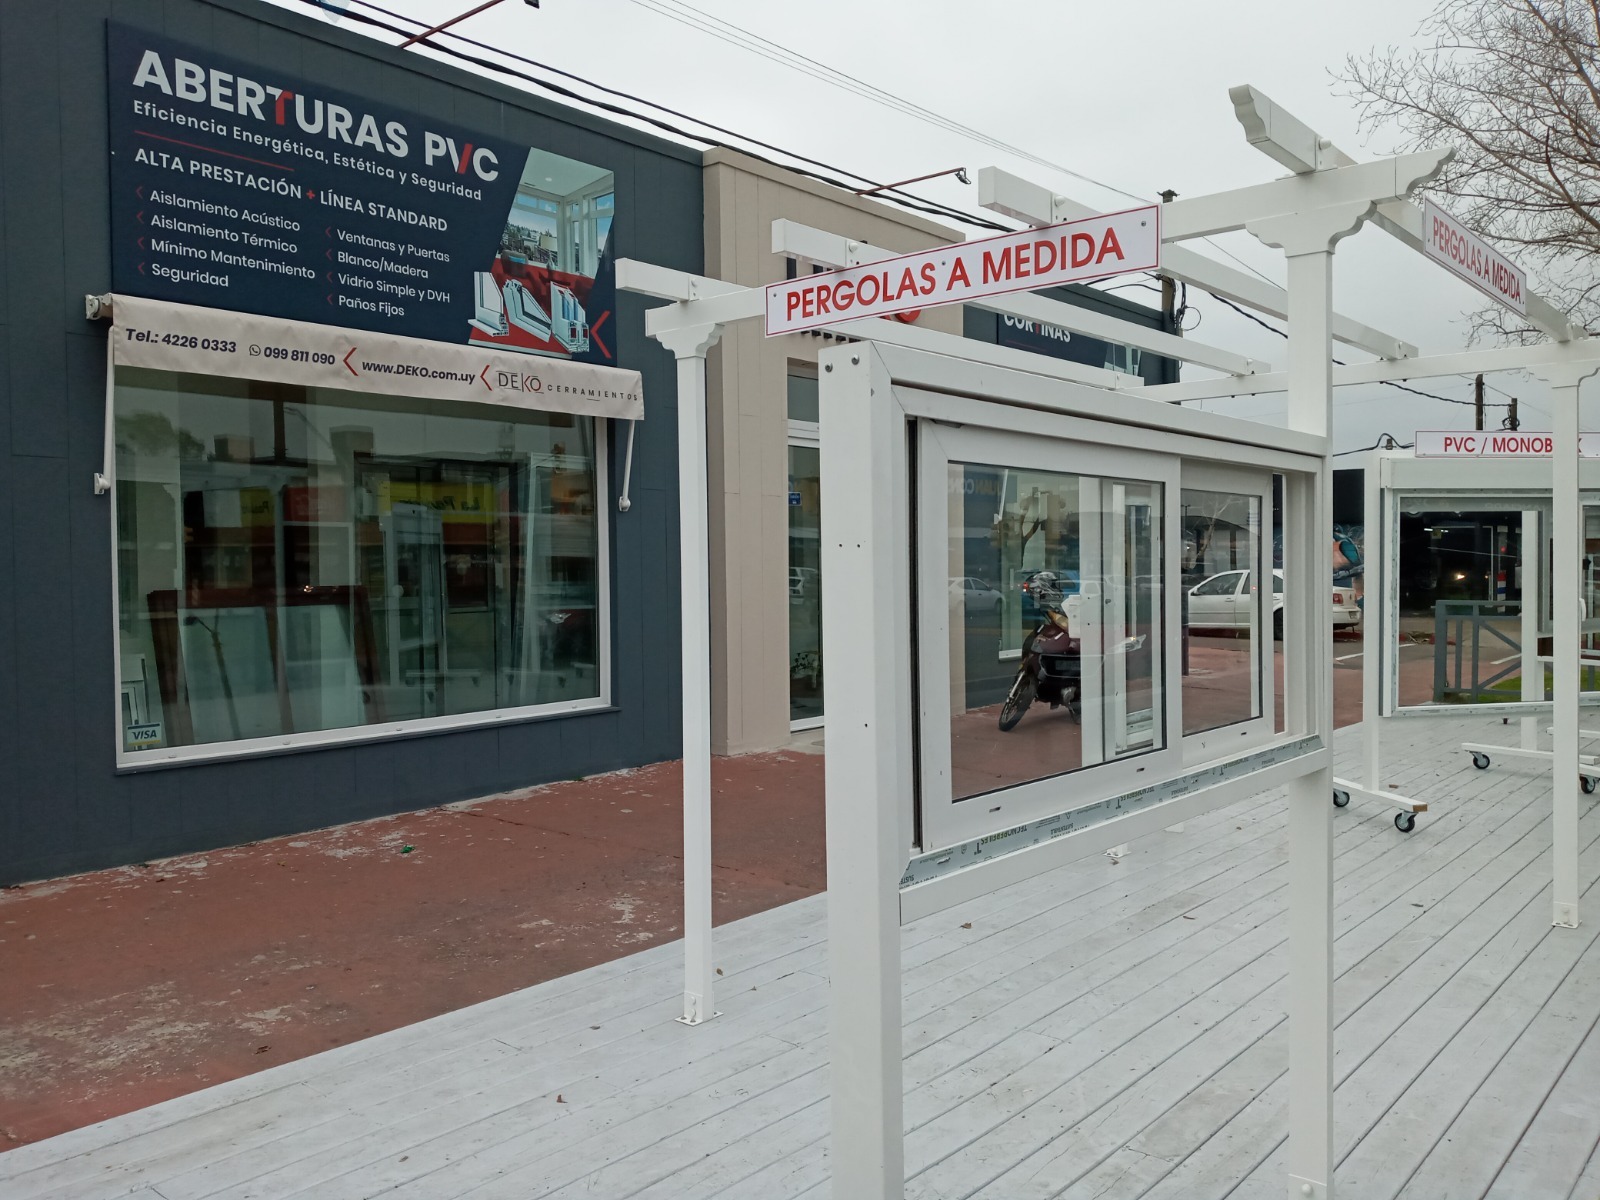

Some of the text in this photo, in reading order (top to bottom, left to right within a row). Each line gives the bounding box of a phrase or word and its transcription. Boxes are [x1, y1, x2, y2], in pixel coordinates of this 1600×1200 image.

[132, 49, 499, 182] ABERTURAS PVC
[134, 100, 482, 201] Eficiencia Energética, Estética y Seguridad
[134, 148, 184, 173] ALTA
[190, 160, 301, 199] PRESTACIÓN
[320, 188, 364, 214] LÍNEA
[368, 201, 448, 232] STANDARD
[150, 190, 300, 232] Aislamiento Acústico
[150, 214, 298, 253] Aislamiento Térmico
[337, 228, 450, 262] Ventanas y Puertas
[151, 238, 316, 280] Mínimo Mantenimiento
[337, 251, 429, 279] Blanco/Madera
[787, 227, 1125, 321] PERGOLAS A MEDIDA
[1433, 215, 1521, 305] PERGOLAS A MEDIDA
[151, 263, 229, 287] Seguridad
[338, 273, 450, 304] Vidrio Simple y DVH
[338, 294, 405, 317] Paños Fijos
[125, 328, 237, 353] Tel.: 4226 0333
[264, 346, 336, 365] 099 811 090
[361, 361, 476, 385] www.DEKO.com.uy
[498, 371, 638, 402] DEKO CERRAMIENTOS
[1444, 437, 1476, 453] PVC
[132, 729, 157, 740] VISA
